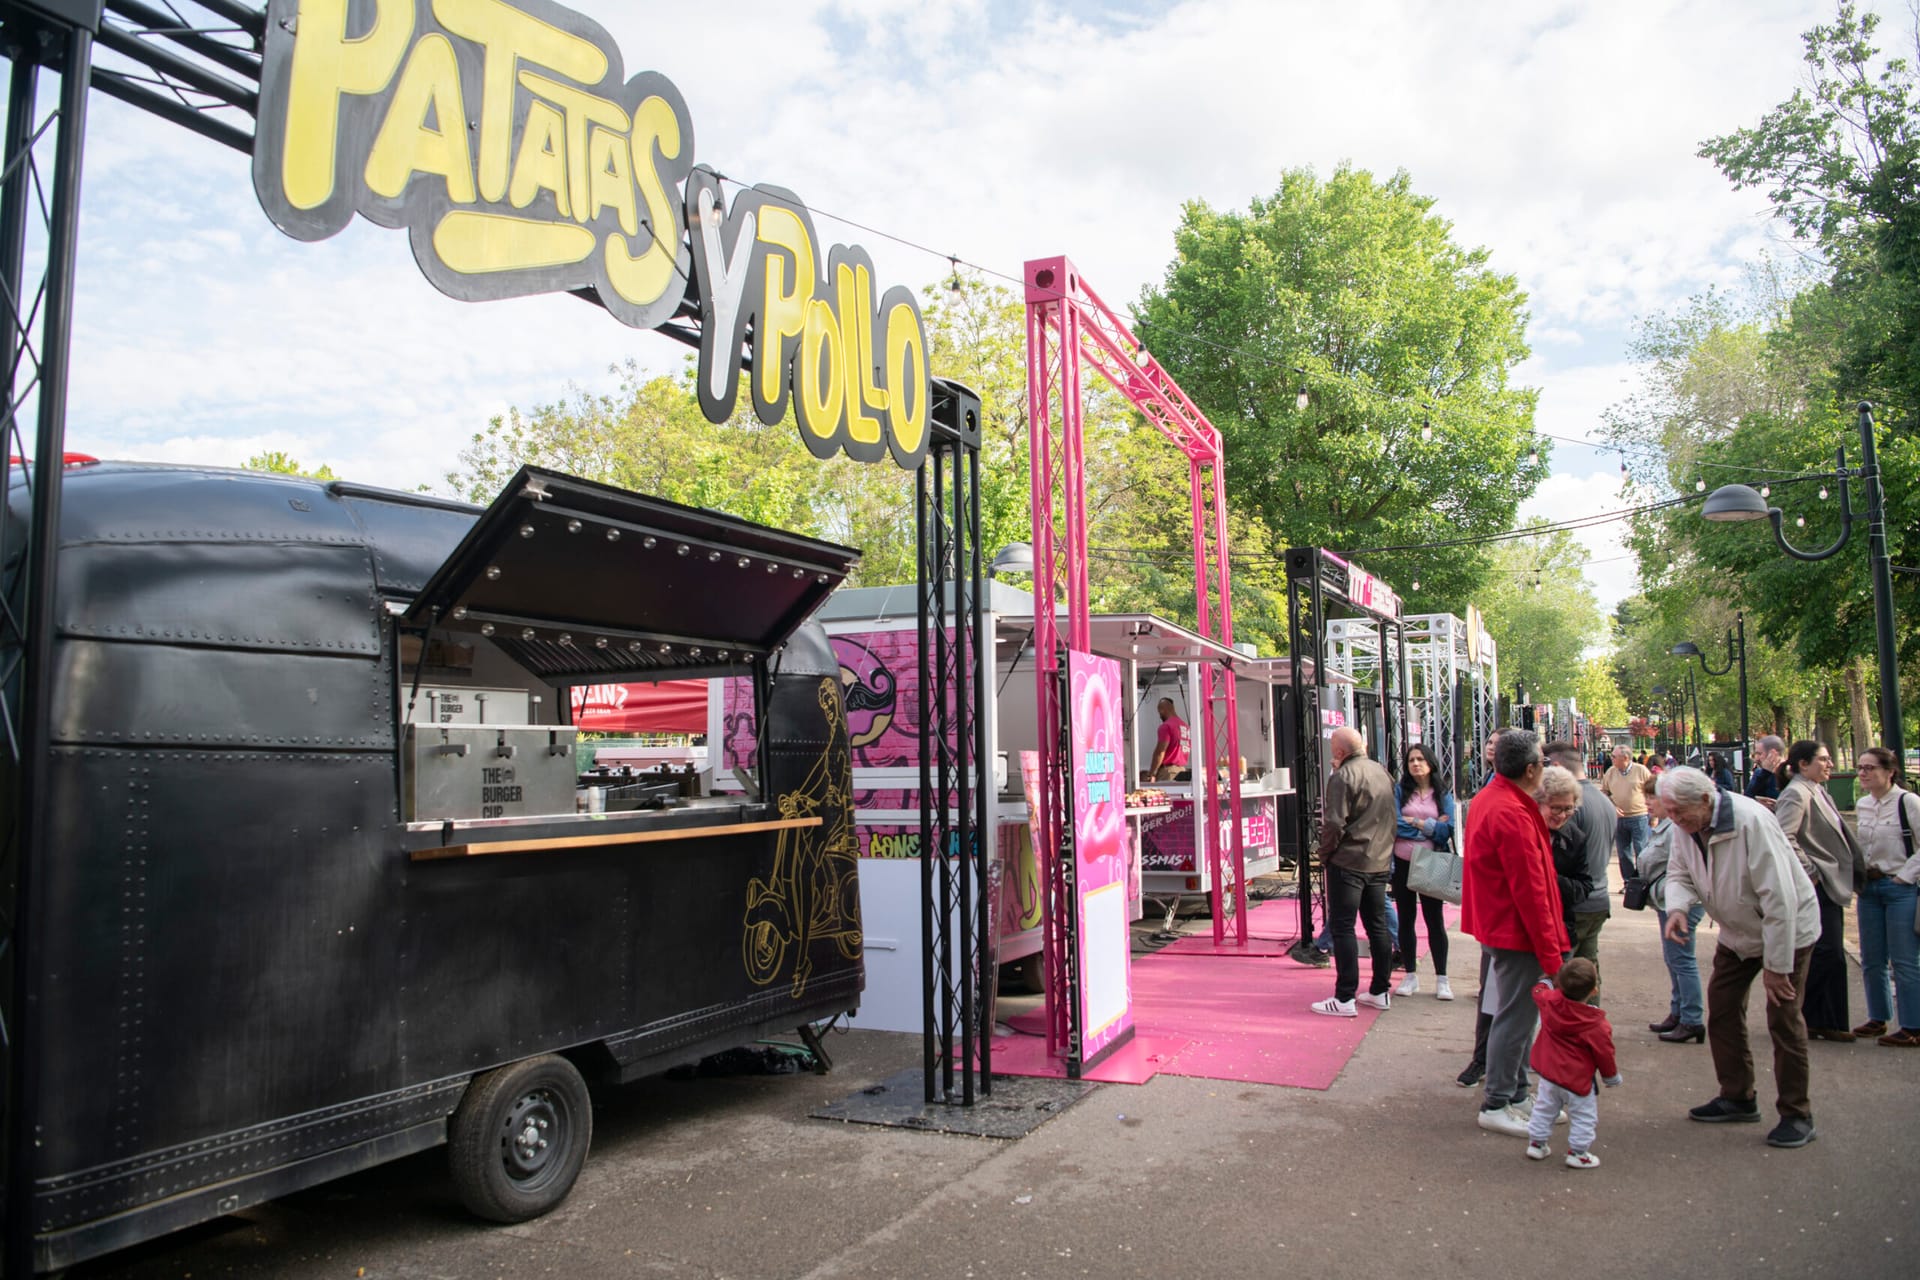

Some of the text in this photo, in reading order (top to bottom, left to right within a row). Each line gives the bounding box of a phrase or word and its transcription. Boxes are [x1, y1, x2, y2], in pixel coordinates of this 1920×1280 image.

[283, 0, 681, 306] PATATAS
[698, 188, 927, 455] Y POLLO
[441, 703, 463, 713] BURGER
[482, 767, 501, 784] THE
[482, 786, 522, 803] BURGER
[482, 805, 503, 819] CUP
